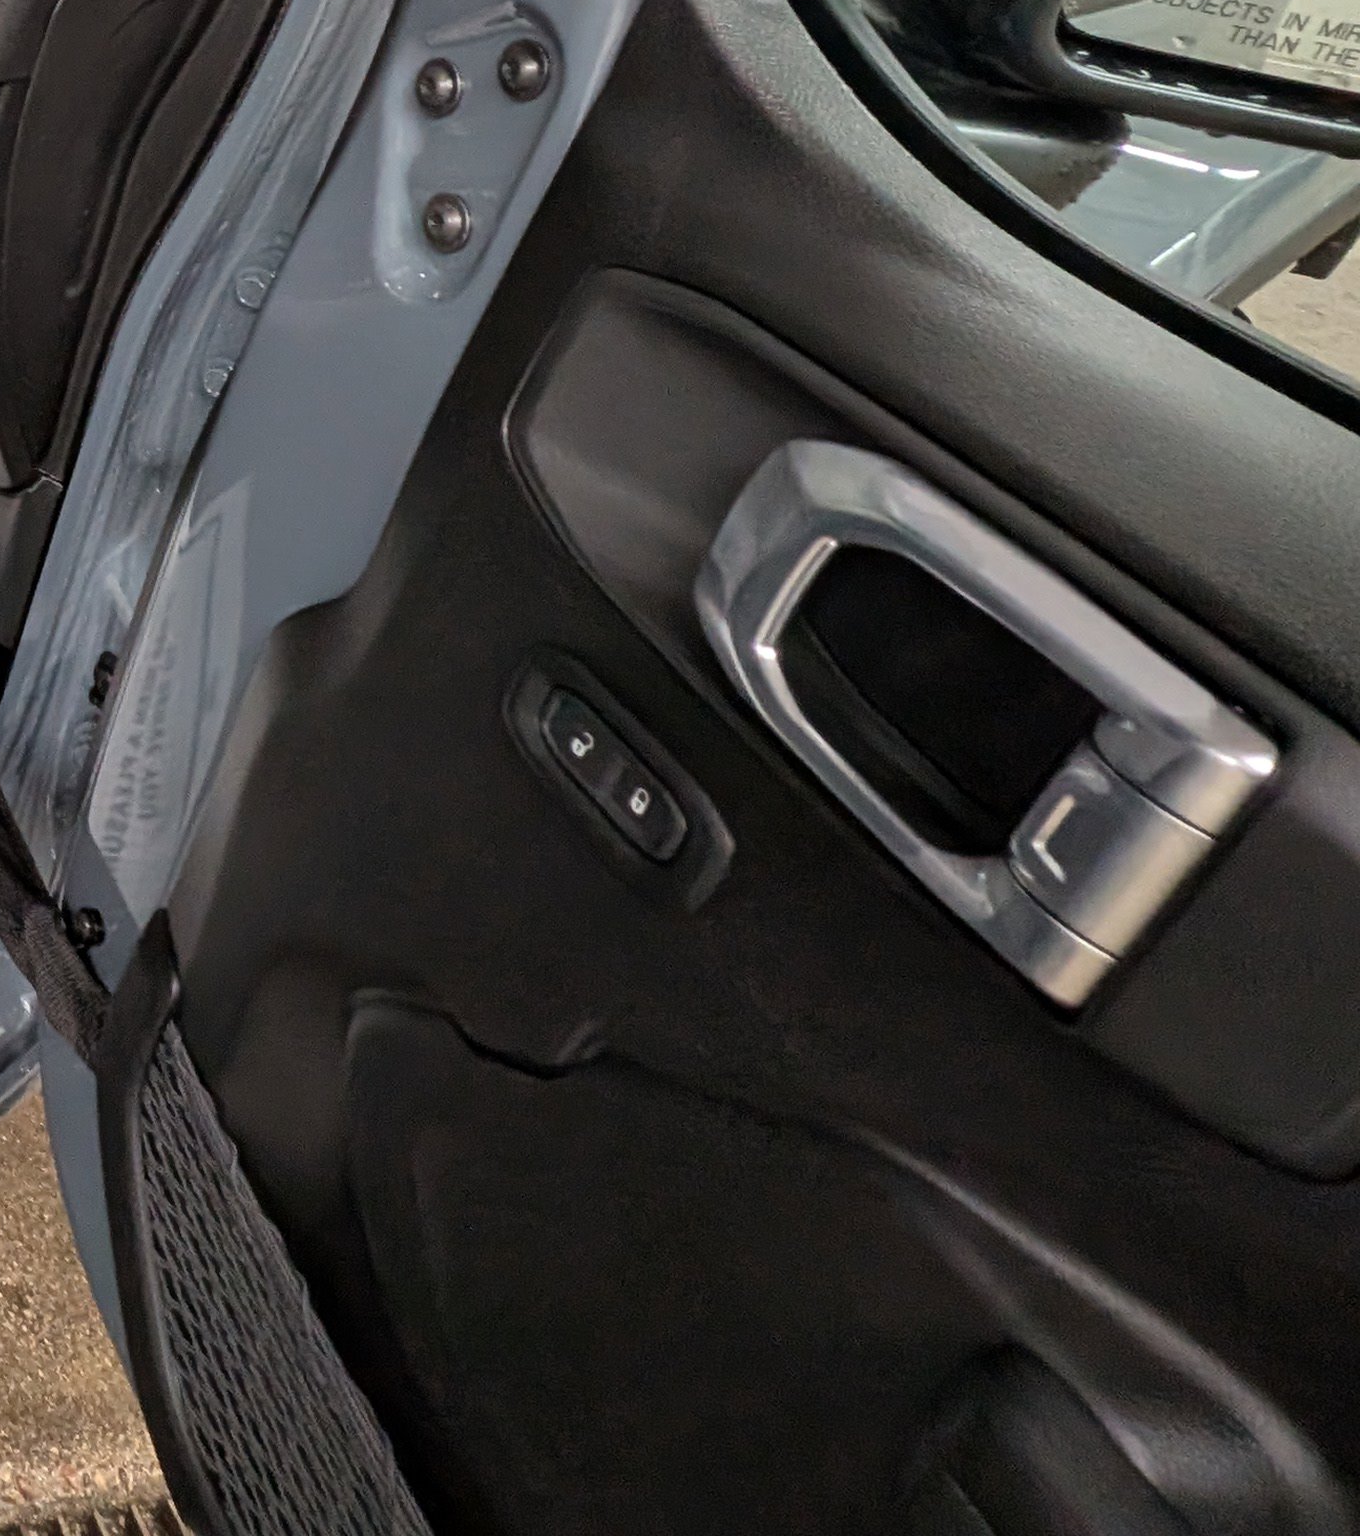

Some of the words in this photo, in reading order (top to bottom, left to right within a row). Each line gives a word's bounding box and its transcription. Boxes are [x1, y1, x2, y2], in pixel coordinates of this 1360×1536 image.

[1281, 10, 1311, 33] IN
[1227, 24, 1302, 56] THAN
[1311, 40, 1360, 68] THE
